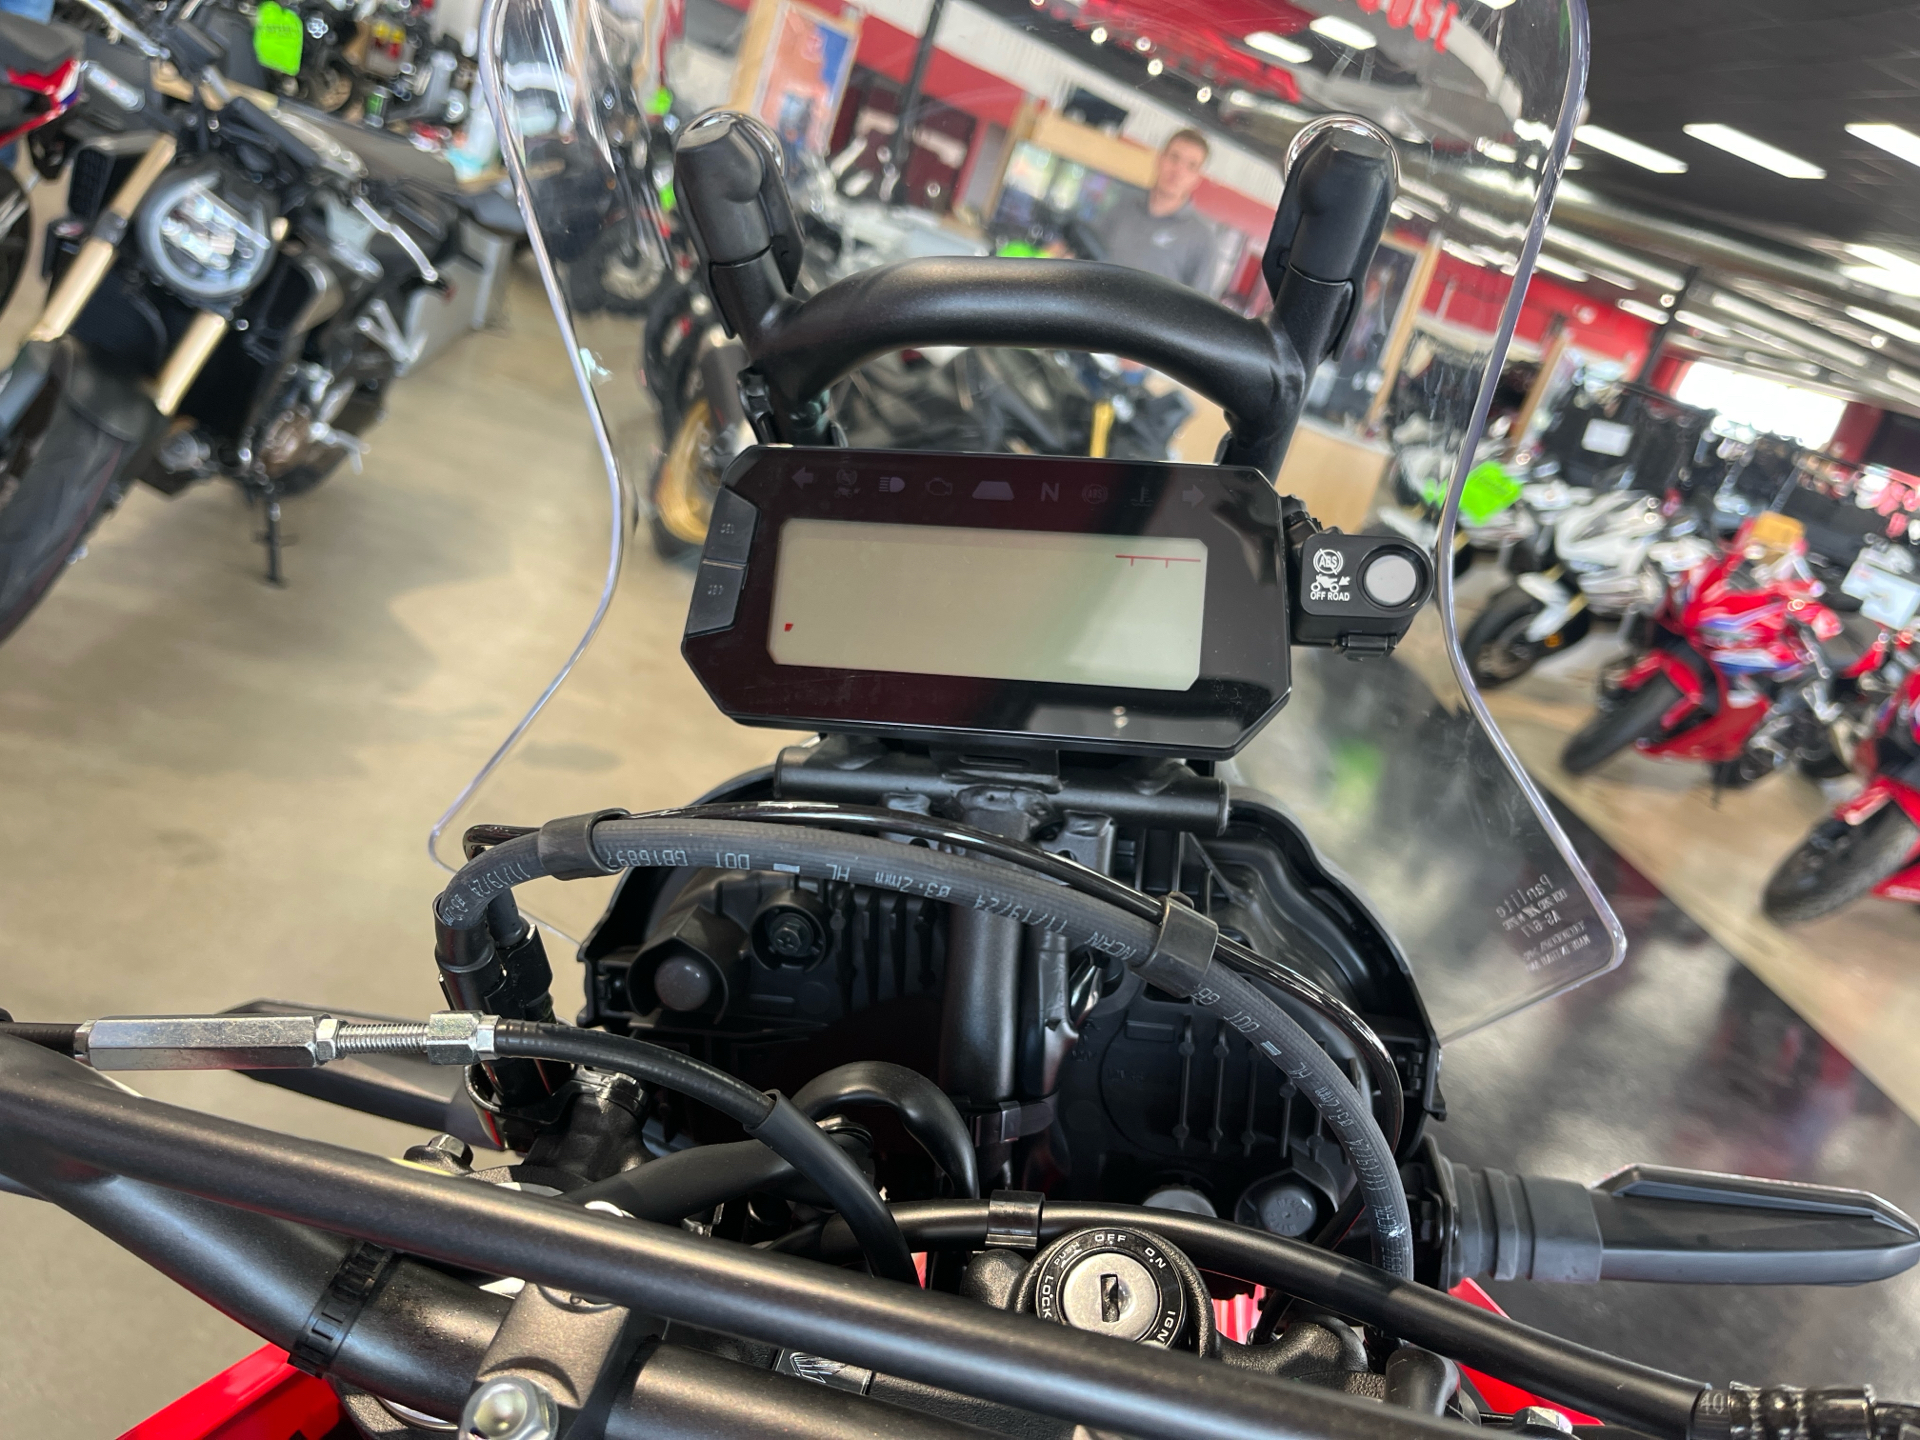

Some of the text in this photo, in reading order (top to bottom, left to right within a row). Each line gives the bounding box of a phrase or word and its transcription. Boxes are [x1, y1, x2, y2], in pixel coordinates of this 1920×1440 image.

[1310, 591, 1350, 601] OFF ROAD
[606, 850, 689, 868] GB16897
[715, 852, 751, 870] DOT
[468, 862, 531, 899] 11/19/24
[826, 863, 850, 882] HL
[973, 894, 1068, 934] 11/19/24
[1223, 1010, 1260, 1033] DOT
[1094, 1233, 1127, 1243] OFF
[1053, 1241, 1081, 1266] PUSH
[1144, 1247, 1167, 1269] ON
[1042, 1275, 1055, 1318] LOCK
